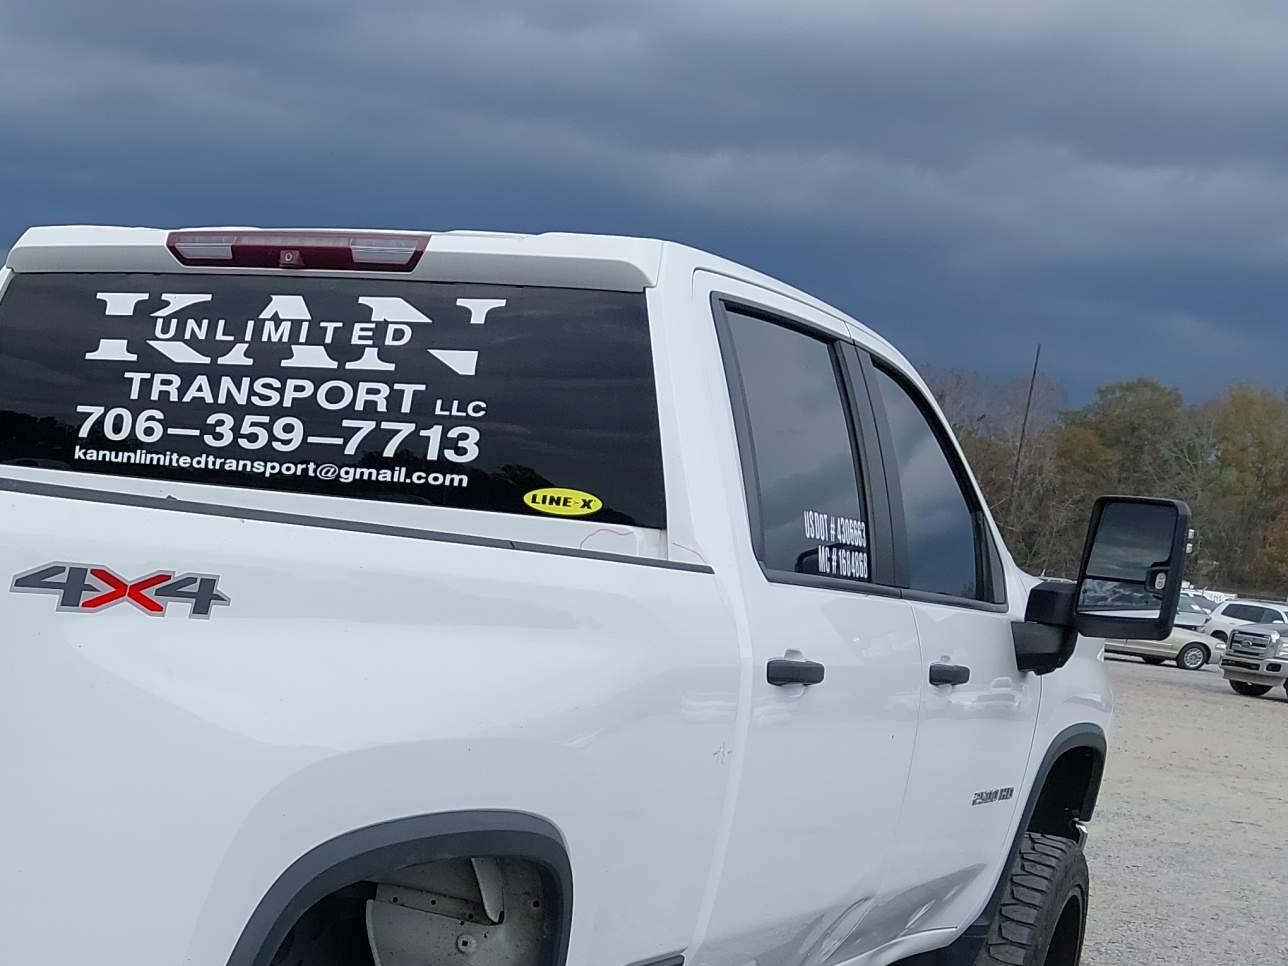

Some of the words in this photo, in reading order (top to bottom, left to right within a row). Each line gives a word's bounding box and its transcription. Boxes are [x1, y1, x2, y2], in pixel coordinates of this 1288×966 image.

[85, 292, 506, 375] KAN
[154, 318, 413, 346] UNLIMITED
[123, 371, 426, 413] TRANSPORT
[434, 399, 487, 417] LLC
[76, 405, 480, 463] 706-359-7713
[74, 445, 468, 487] kanunlimitedtransport@gmail.com
[531, 493, 594, 510] LINE-X
[803, 510, 828, 542] USDOT
[818, 544, 831, 574] MC
